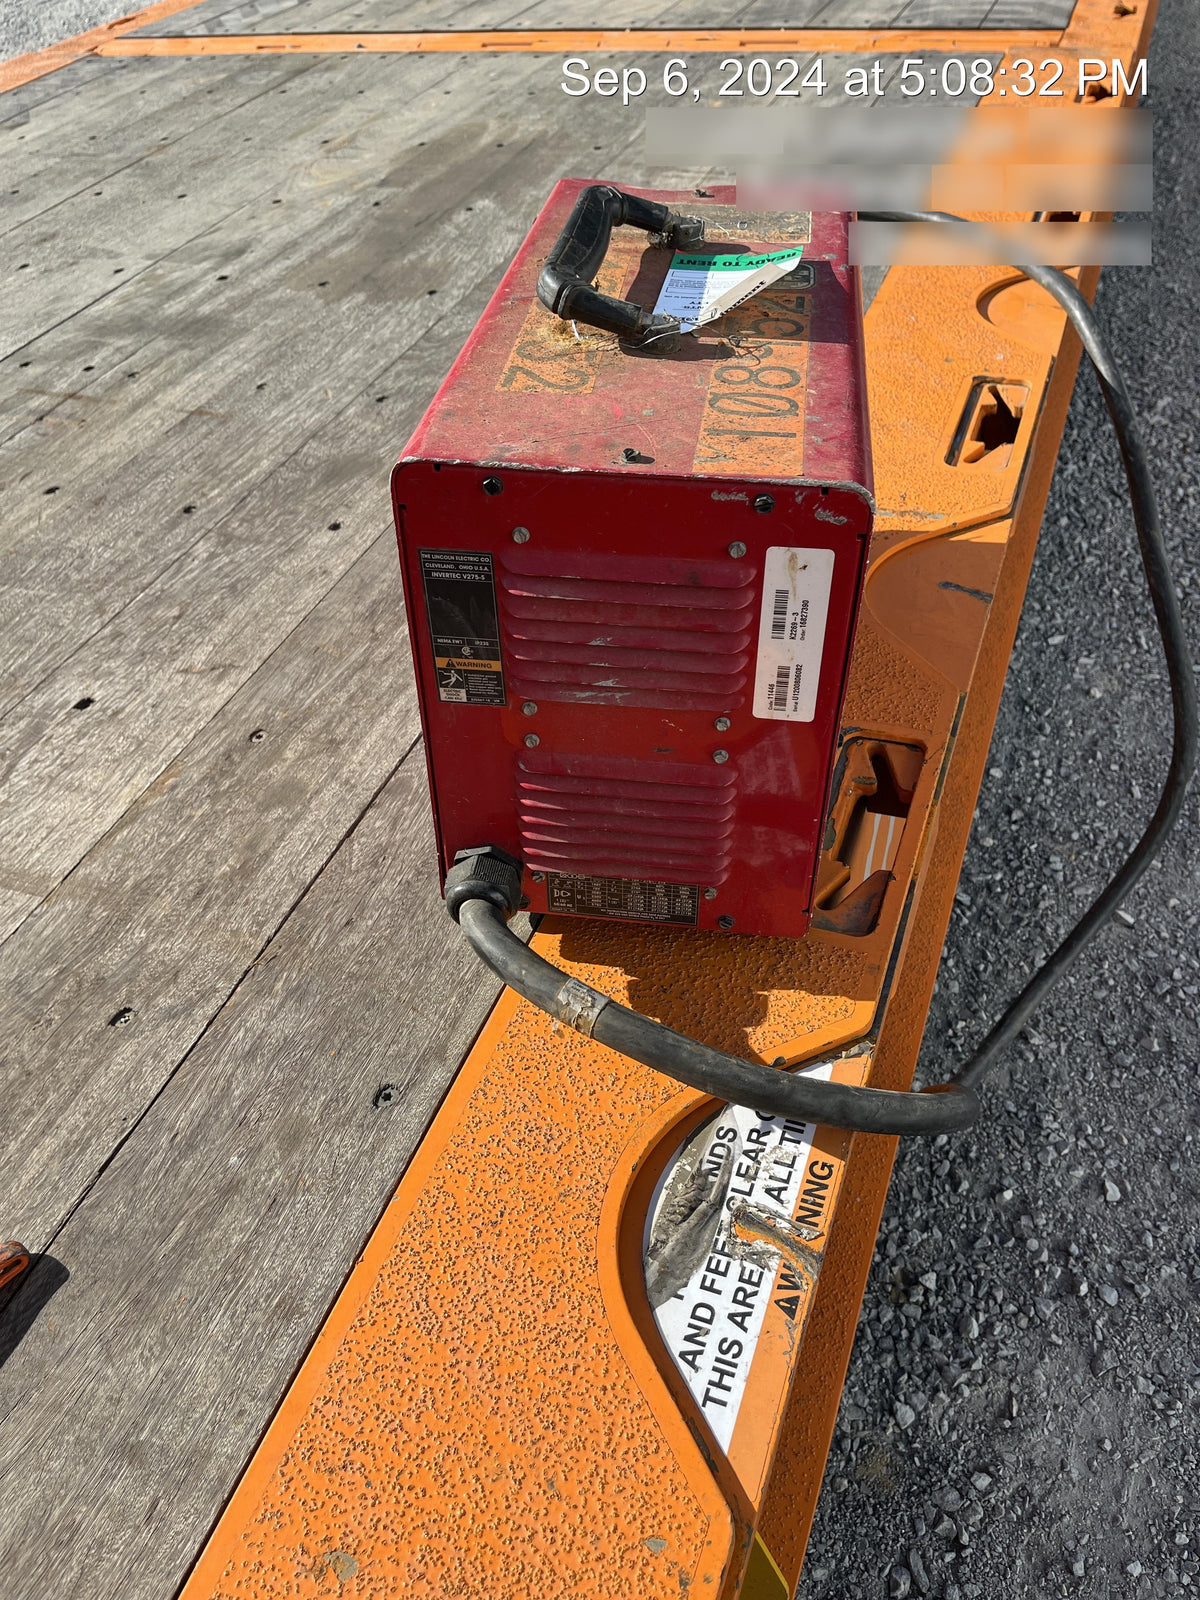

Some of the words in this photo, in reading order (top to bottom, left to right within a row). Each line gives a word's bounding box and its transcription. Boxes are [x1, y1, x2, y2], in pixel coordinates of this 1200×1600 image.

[676, 258, 717, 268] RENT
[723, 260, 742, 268] TO
[431, 553, 455, 561] LINCOLN
[425, 562, 457, 570] CLEVELAND,
[431, 571, 461, 579] INVERTEC
[462, 573, 486, 581] V275-S
[455, 661, 493, 669] WARNING
[767, 683, 775, 700] 11446
[702, 1337, 744, 1409] THIS
[764, 1154, 798, 1206] ALL
[678, 1302, 716, 1373] AND
